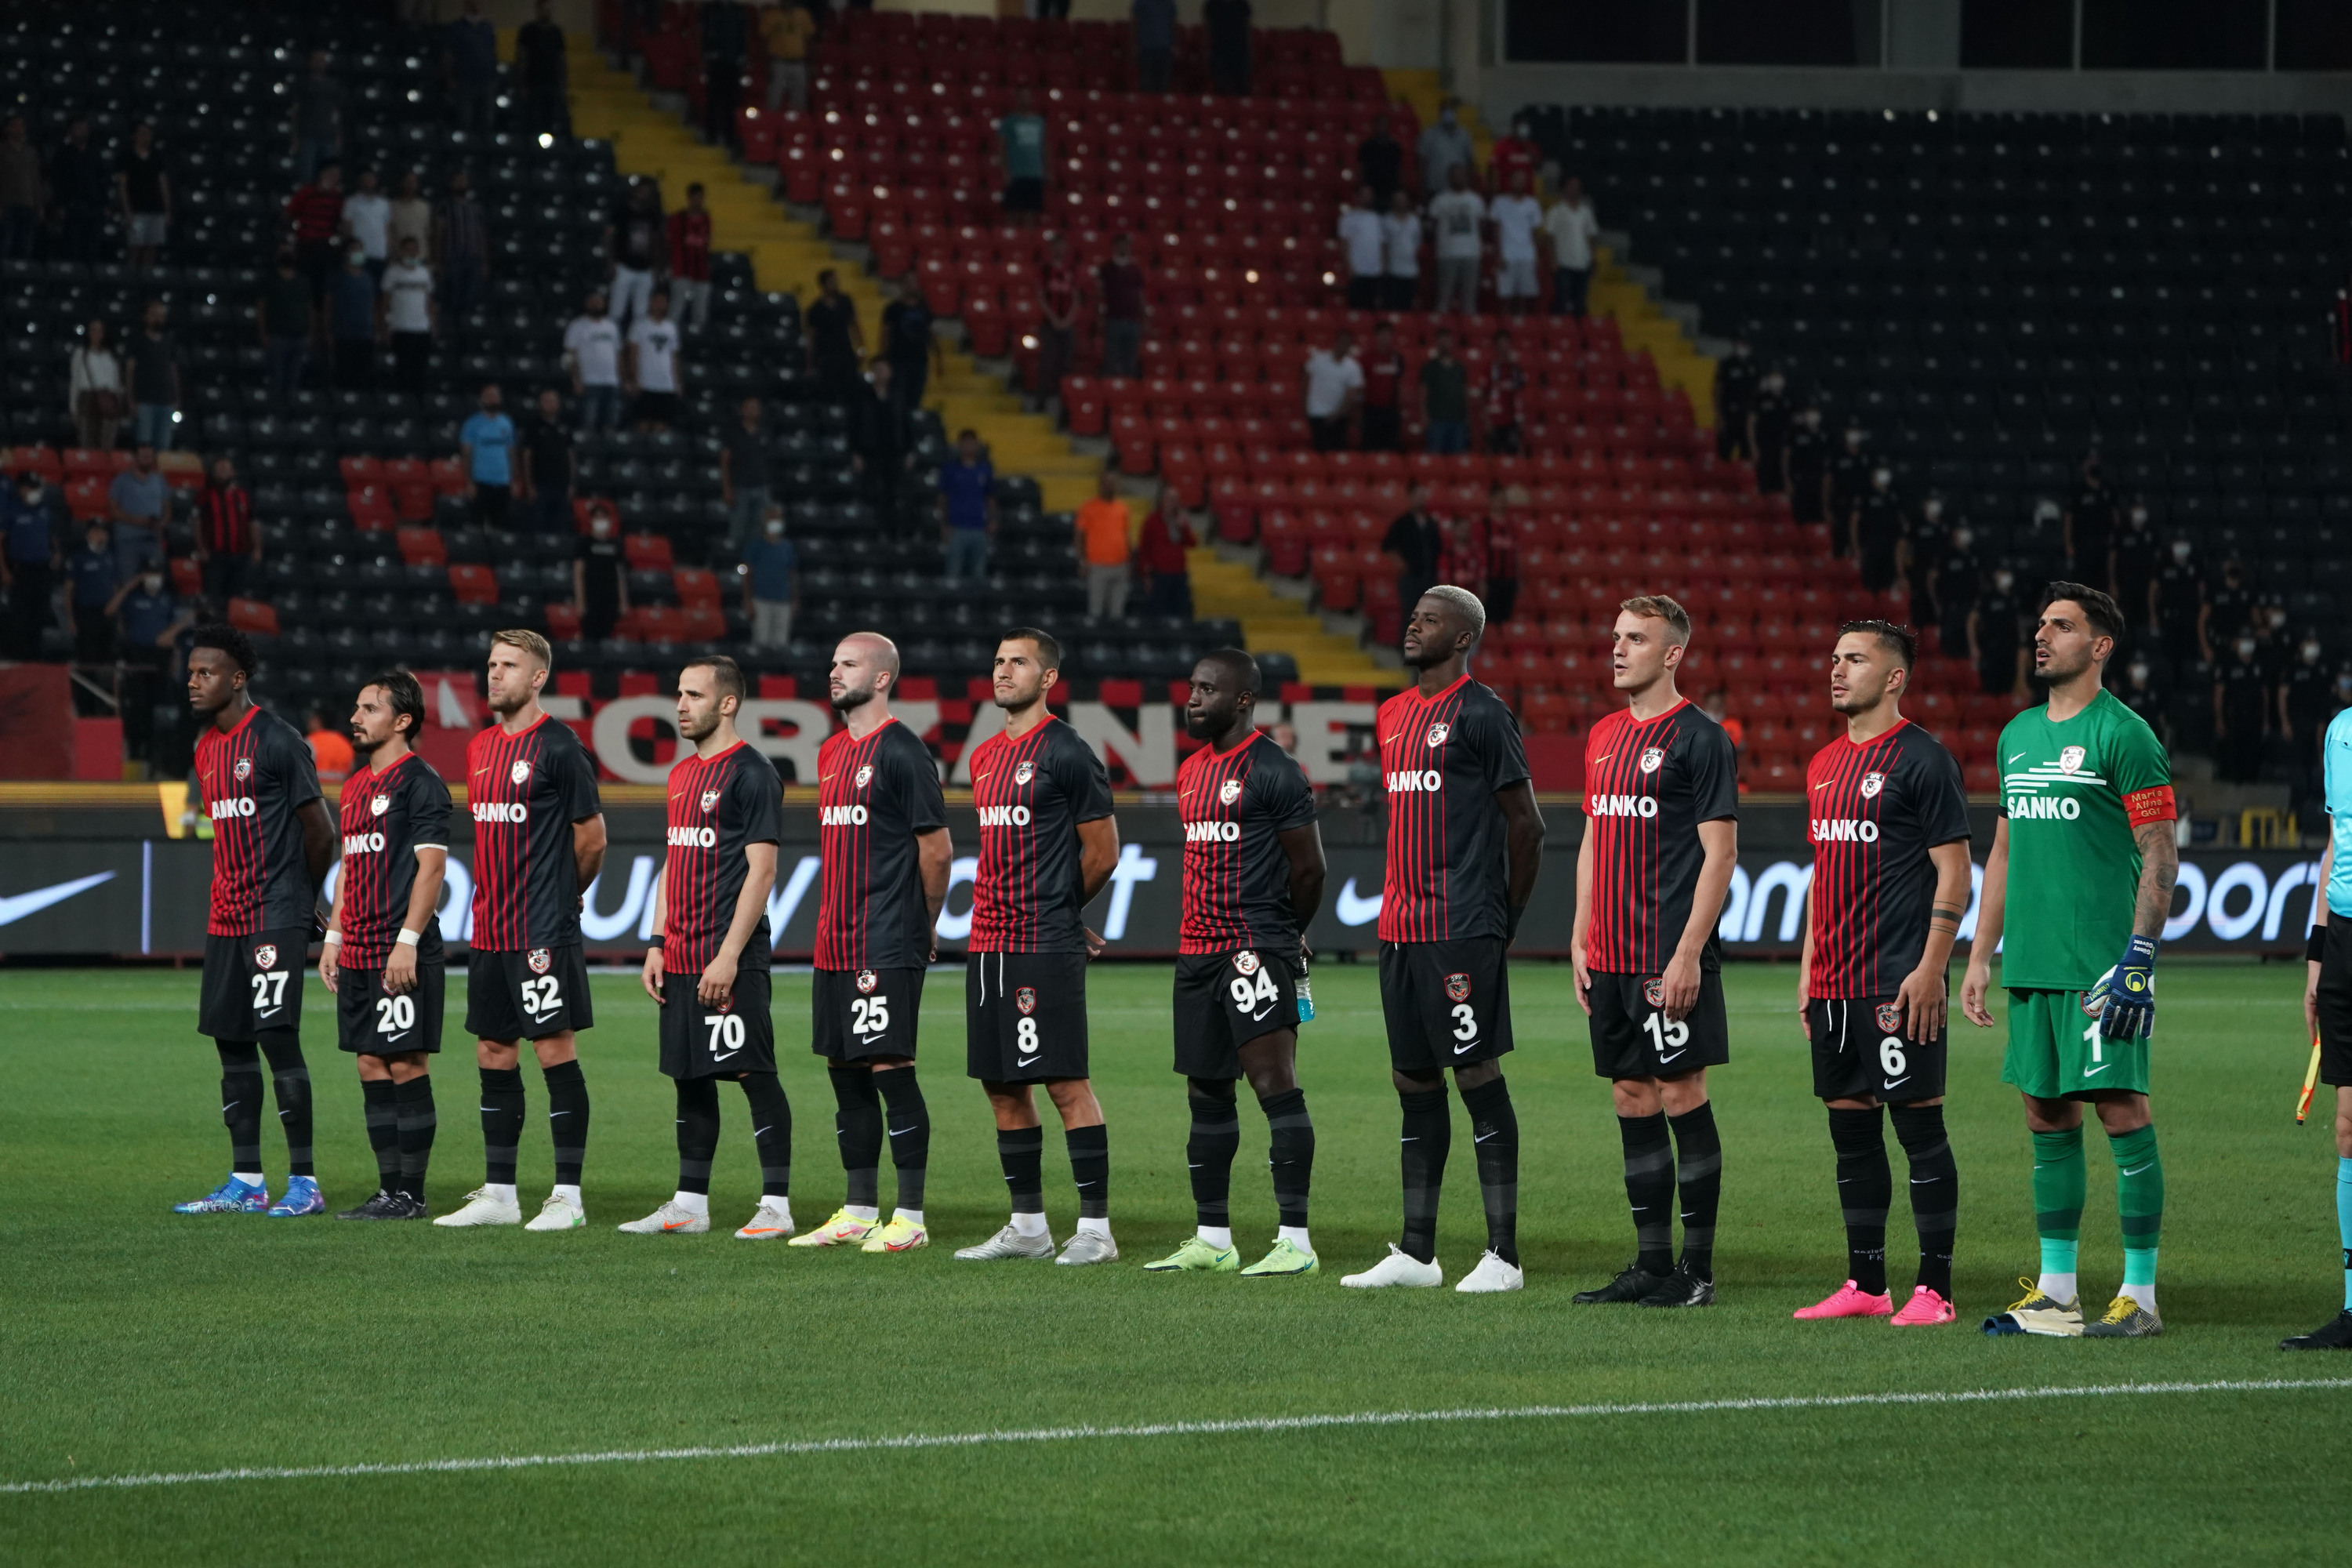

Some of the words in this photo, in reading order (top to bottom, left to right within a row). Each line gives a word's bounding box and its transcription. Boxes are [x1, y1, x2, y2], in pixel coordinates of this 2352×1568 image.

[1386, 770, 1441, 793] ANKO
[212, 797, 256, 820] ANKO
[472, 802, 527, 823] SANKO
[820, 804, 868, 826] ANKO
[976, 805, 1031, 826] ANKO
[1592, 794, 1658, 818] SANKO
[2006, 796, 2081, 820] SANKO
[2136, 799, 2163, 811] Alina
[2141, 808, 2161, 817] GG1
[344, 832, 385, 855] ANKO
[1811, 818, 1879, 843] SANKO
[252, 971, 289, 1009] 27
[521, 975, 563, 1014] 52
[1230, 965, 1279, 1014] 94
[376, 995, 415, 1033] 20
[851, 996, 889, 1034] 25
[1451, 1004, 1478, 1041] 3
[705, 1014, 745, 1051] 70
[1017, 1017, 1039, 1053] 8
[1642, 1011, 1690, 1051] 15
[2083, 1021, 2102, 1062] 1
[1879, 1036, 1906, 1076] 6
